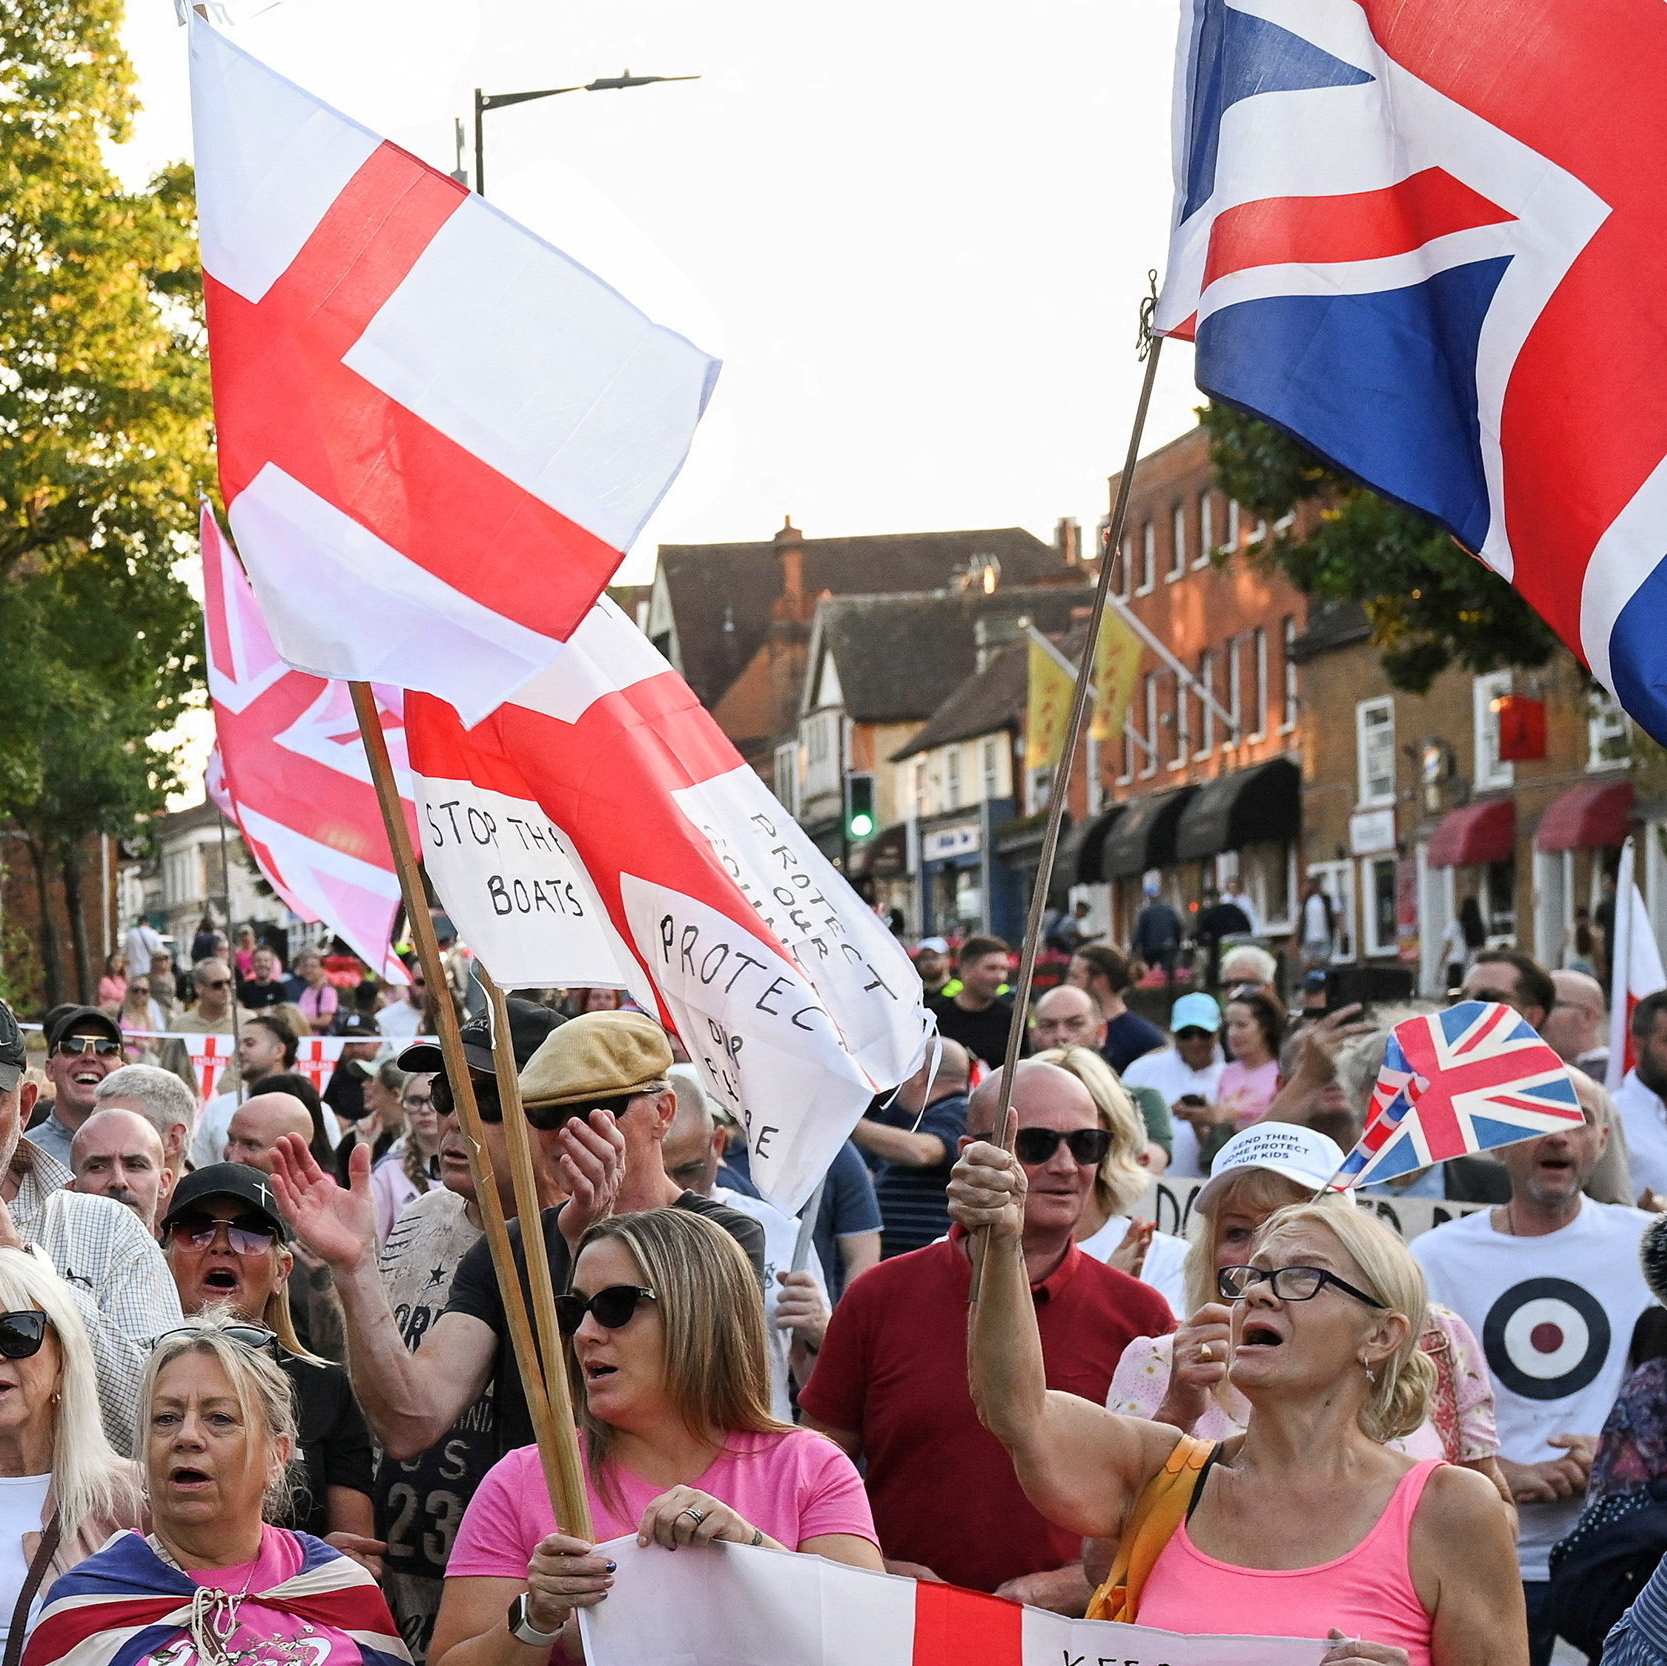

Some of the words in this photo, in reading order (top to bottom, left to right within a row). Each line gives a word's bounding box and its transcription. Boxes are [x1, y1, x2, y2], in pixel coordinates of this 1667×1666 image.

[426, 800, 499, 849] STOP
[487, 875, 584, 916] BOATS
[750, 812, 898, 1001] PROTECT
[773, 886, 829, 960] OUR
[660, 914, 828, 1032] PROTEC
[1233, 1136, 1261, 1151] SEND
[1266, 1134, 1299, 1142] THEM
[1254, 1142, 1309, 1154] PROTECT
